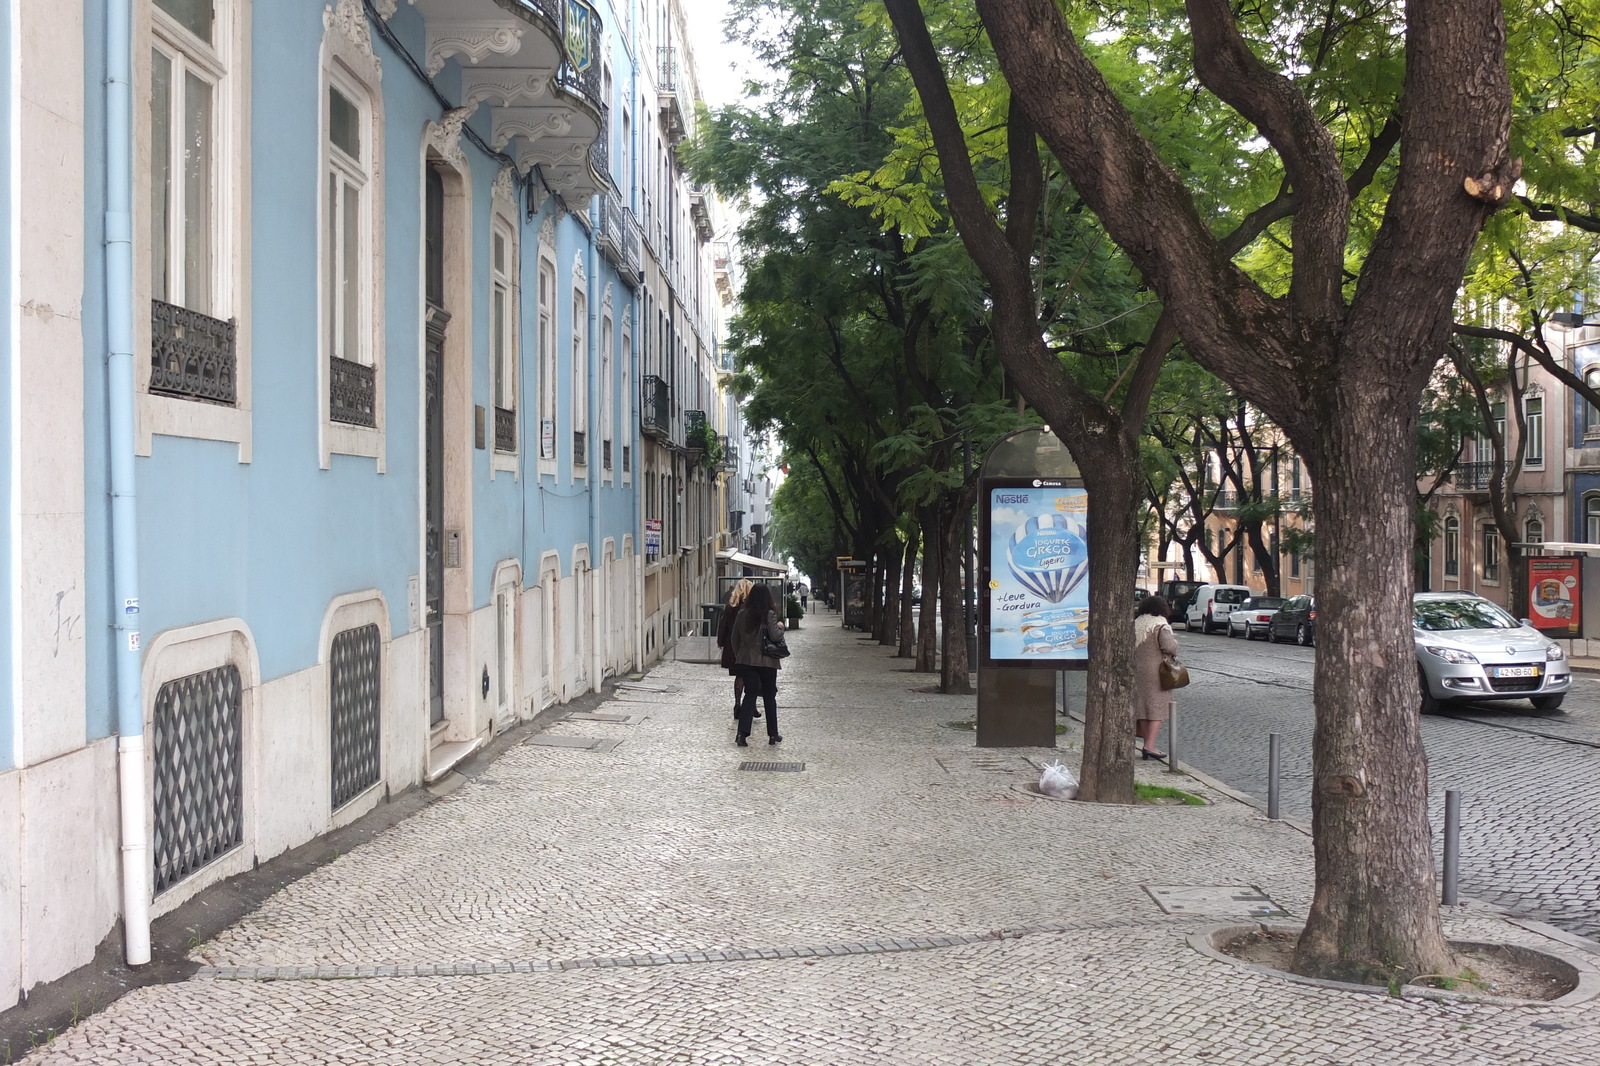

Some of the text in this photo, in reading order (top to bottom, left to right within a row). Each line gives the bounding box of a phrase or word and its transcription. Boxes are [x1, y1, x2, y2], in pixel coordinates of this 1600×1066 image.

[996, 494, 1029, 504] Nestlé
[1026, 545, 1071, 559] GREGO
[1039, 556, 1065, 569] Ligeiro
[1002, 601, 1041, 611] Gordura
